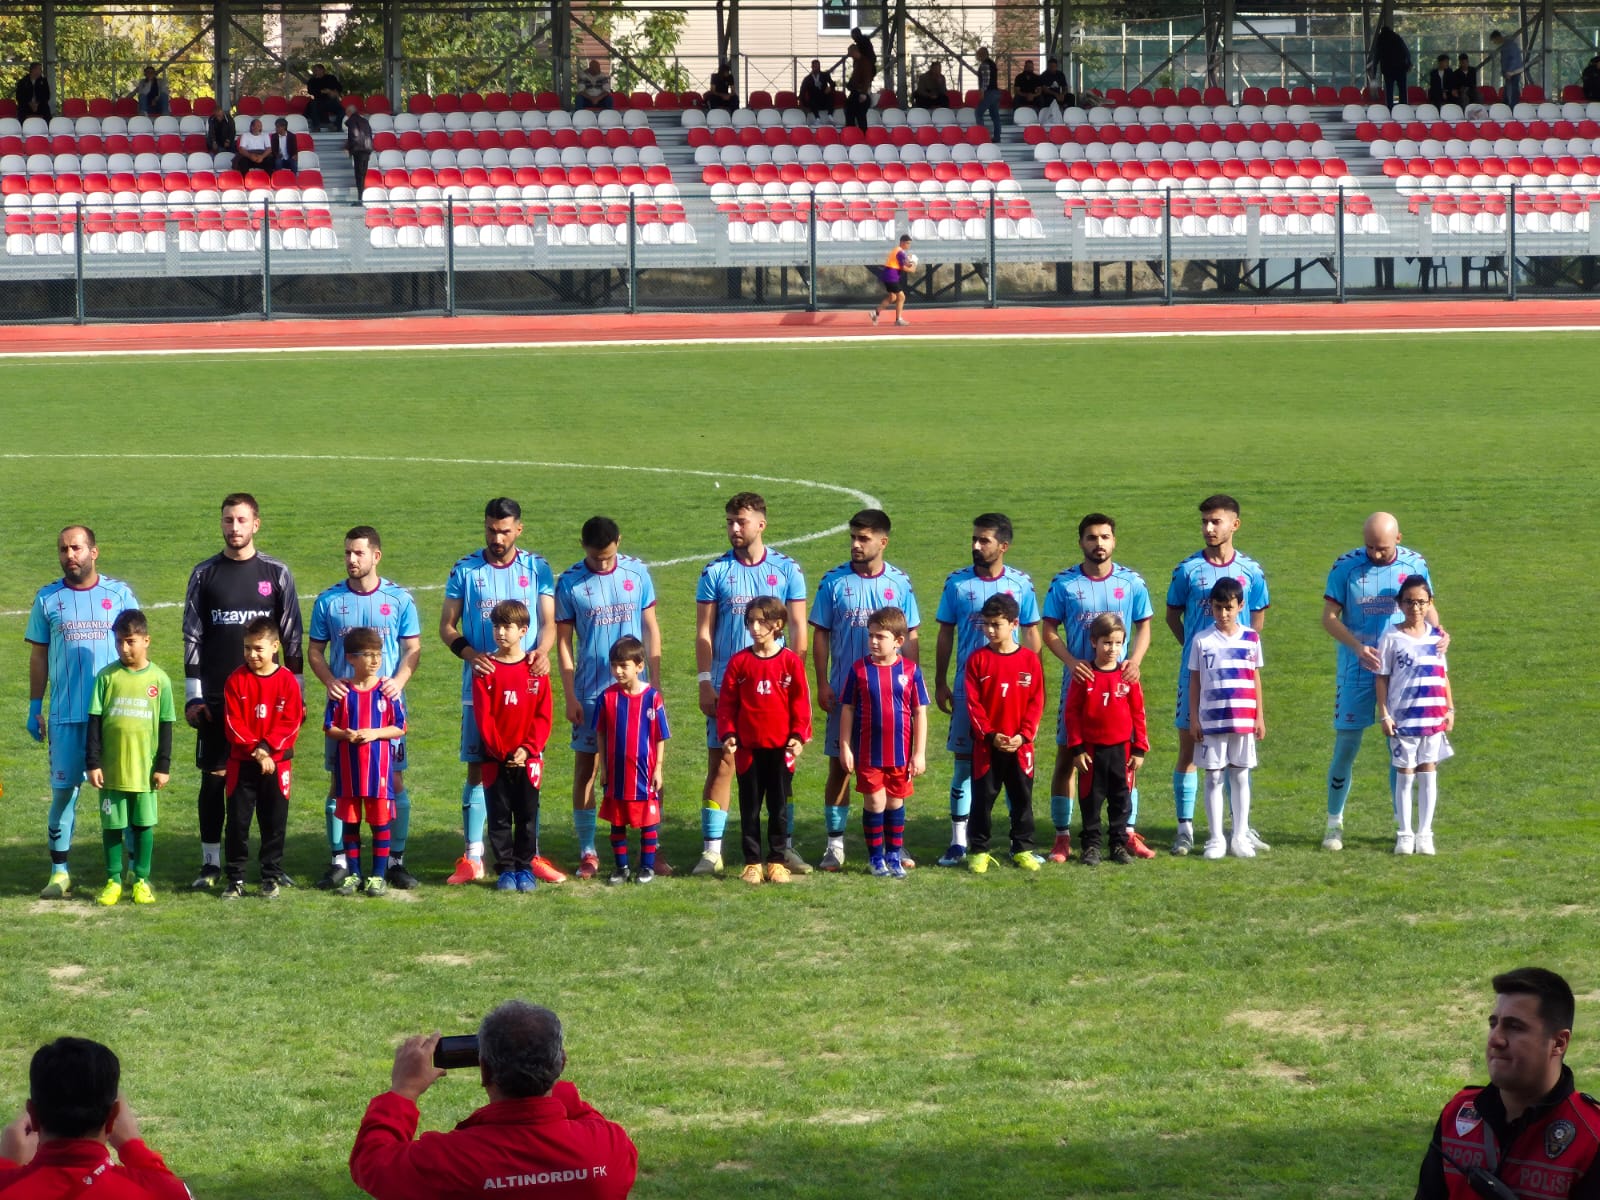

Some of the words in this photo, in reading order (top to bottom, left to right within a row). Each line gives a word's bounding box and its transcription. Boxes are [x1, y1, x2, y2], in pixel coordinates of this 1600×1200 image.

[1203, 654, 1216, 669] 17
[756, 679, 772, 695] 42
[1001, 683, 1009, 697] 7
[504, 690, 518, 705] 74
[1103, 692, 1110, 706] 7
[254, 703, 267, 719] 19
[529, 762, 540, 778] 74
[483, 1168, 588, 1190] ALTINORDU
[592, 1165, 607, 1179] FK
